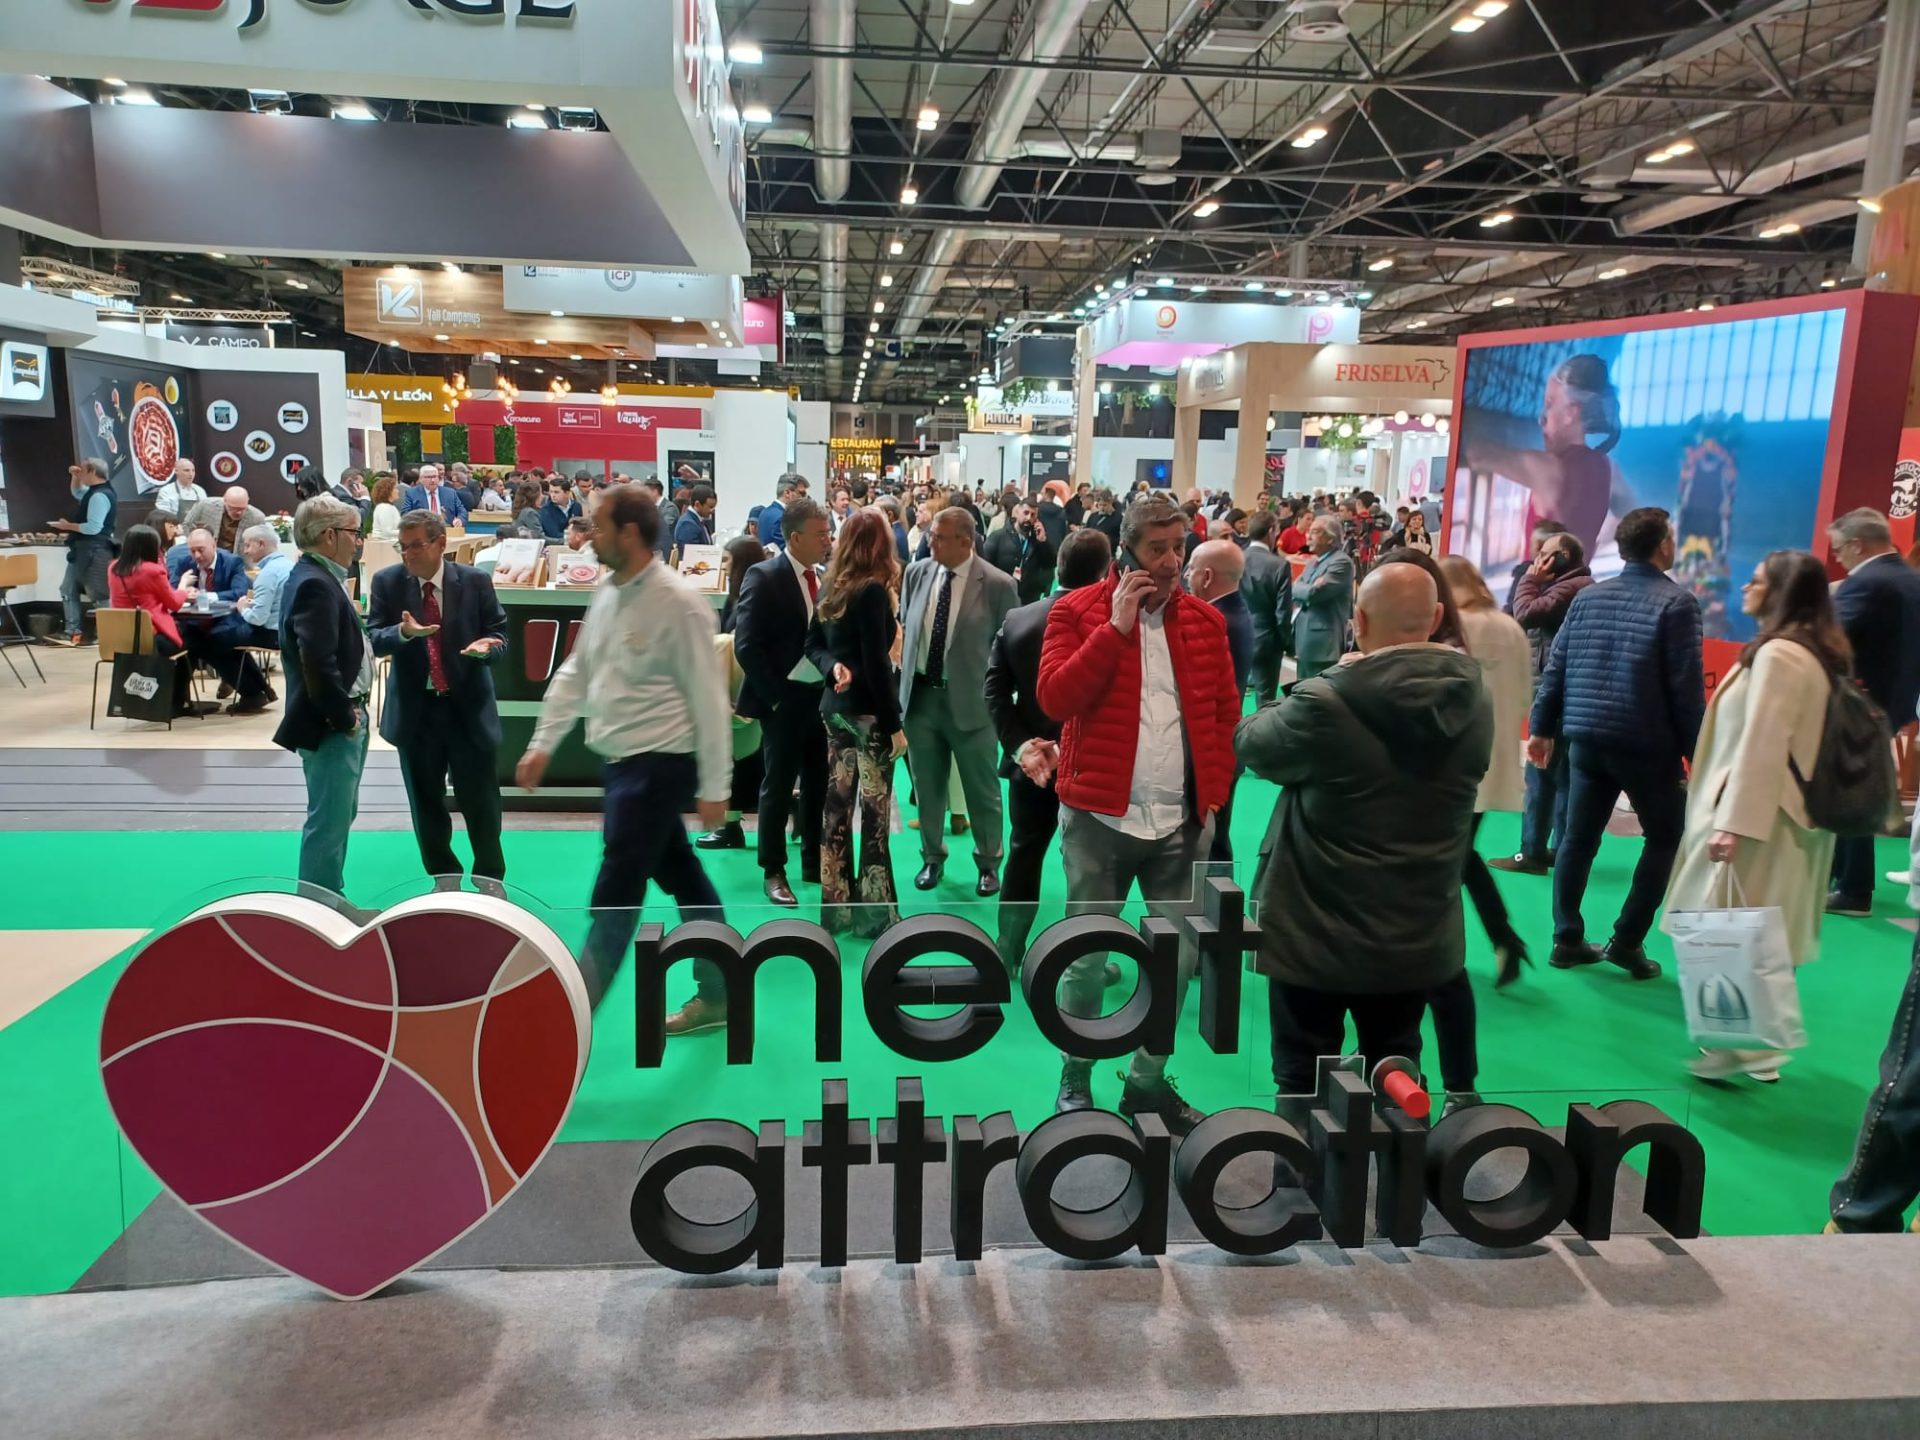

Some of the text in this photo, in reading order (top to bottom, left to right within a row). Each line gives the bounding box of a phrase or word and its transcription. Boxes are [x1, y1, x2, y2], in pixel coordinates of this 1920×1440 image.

[611, 270, 631, 281] ICP
[208, 337, 260, 348] CAMPO
[1335, 363, 1431, 384] FRISELVA
[380, 390, 391, 401] Y
[393, 388, 433, 402] LEÓN
[635, 876, 1262, 1068] meat
[631, 1070, 1705, 1274] attraction
